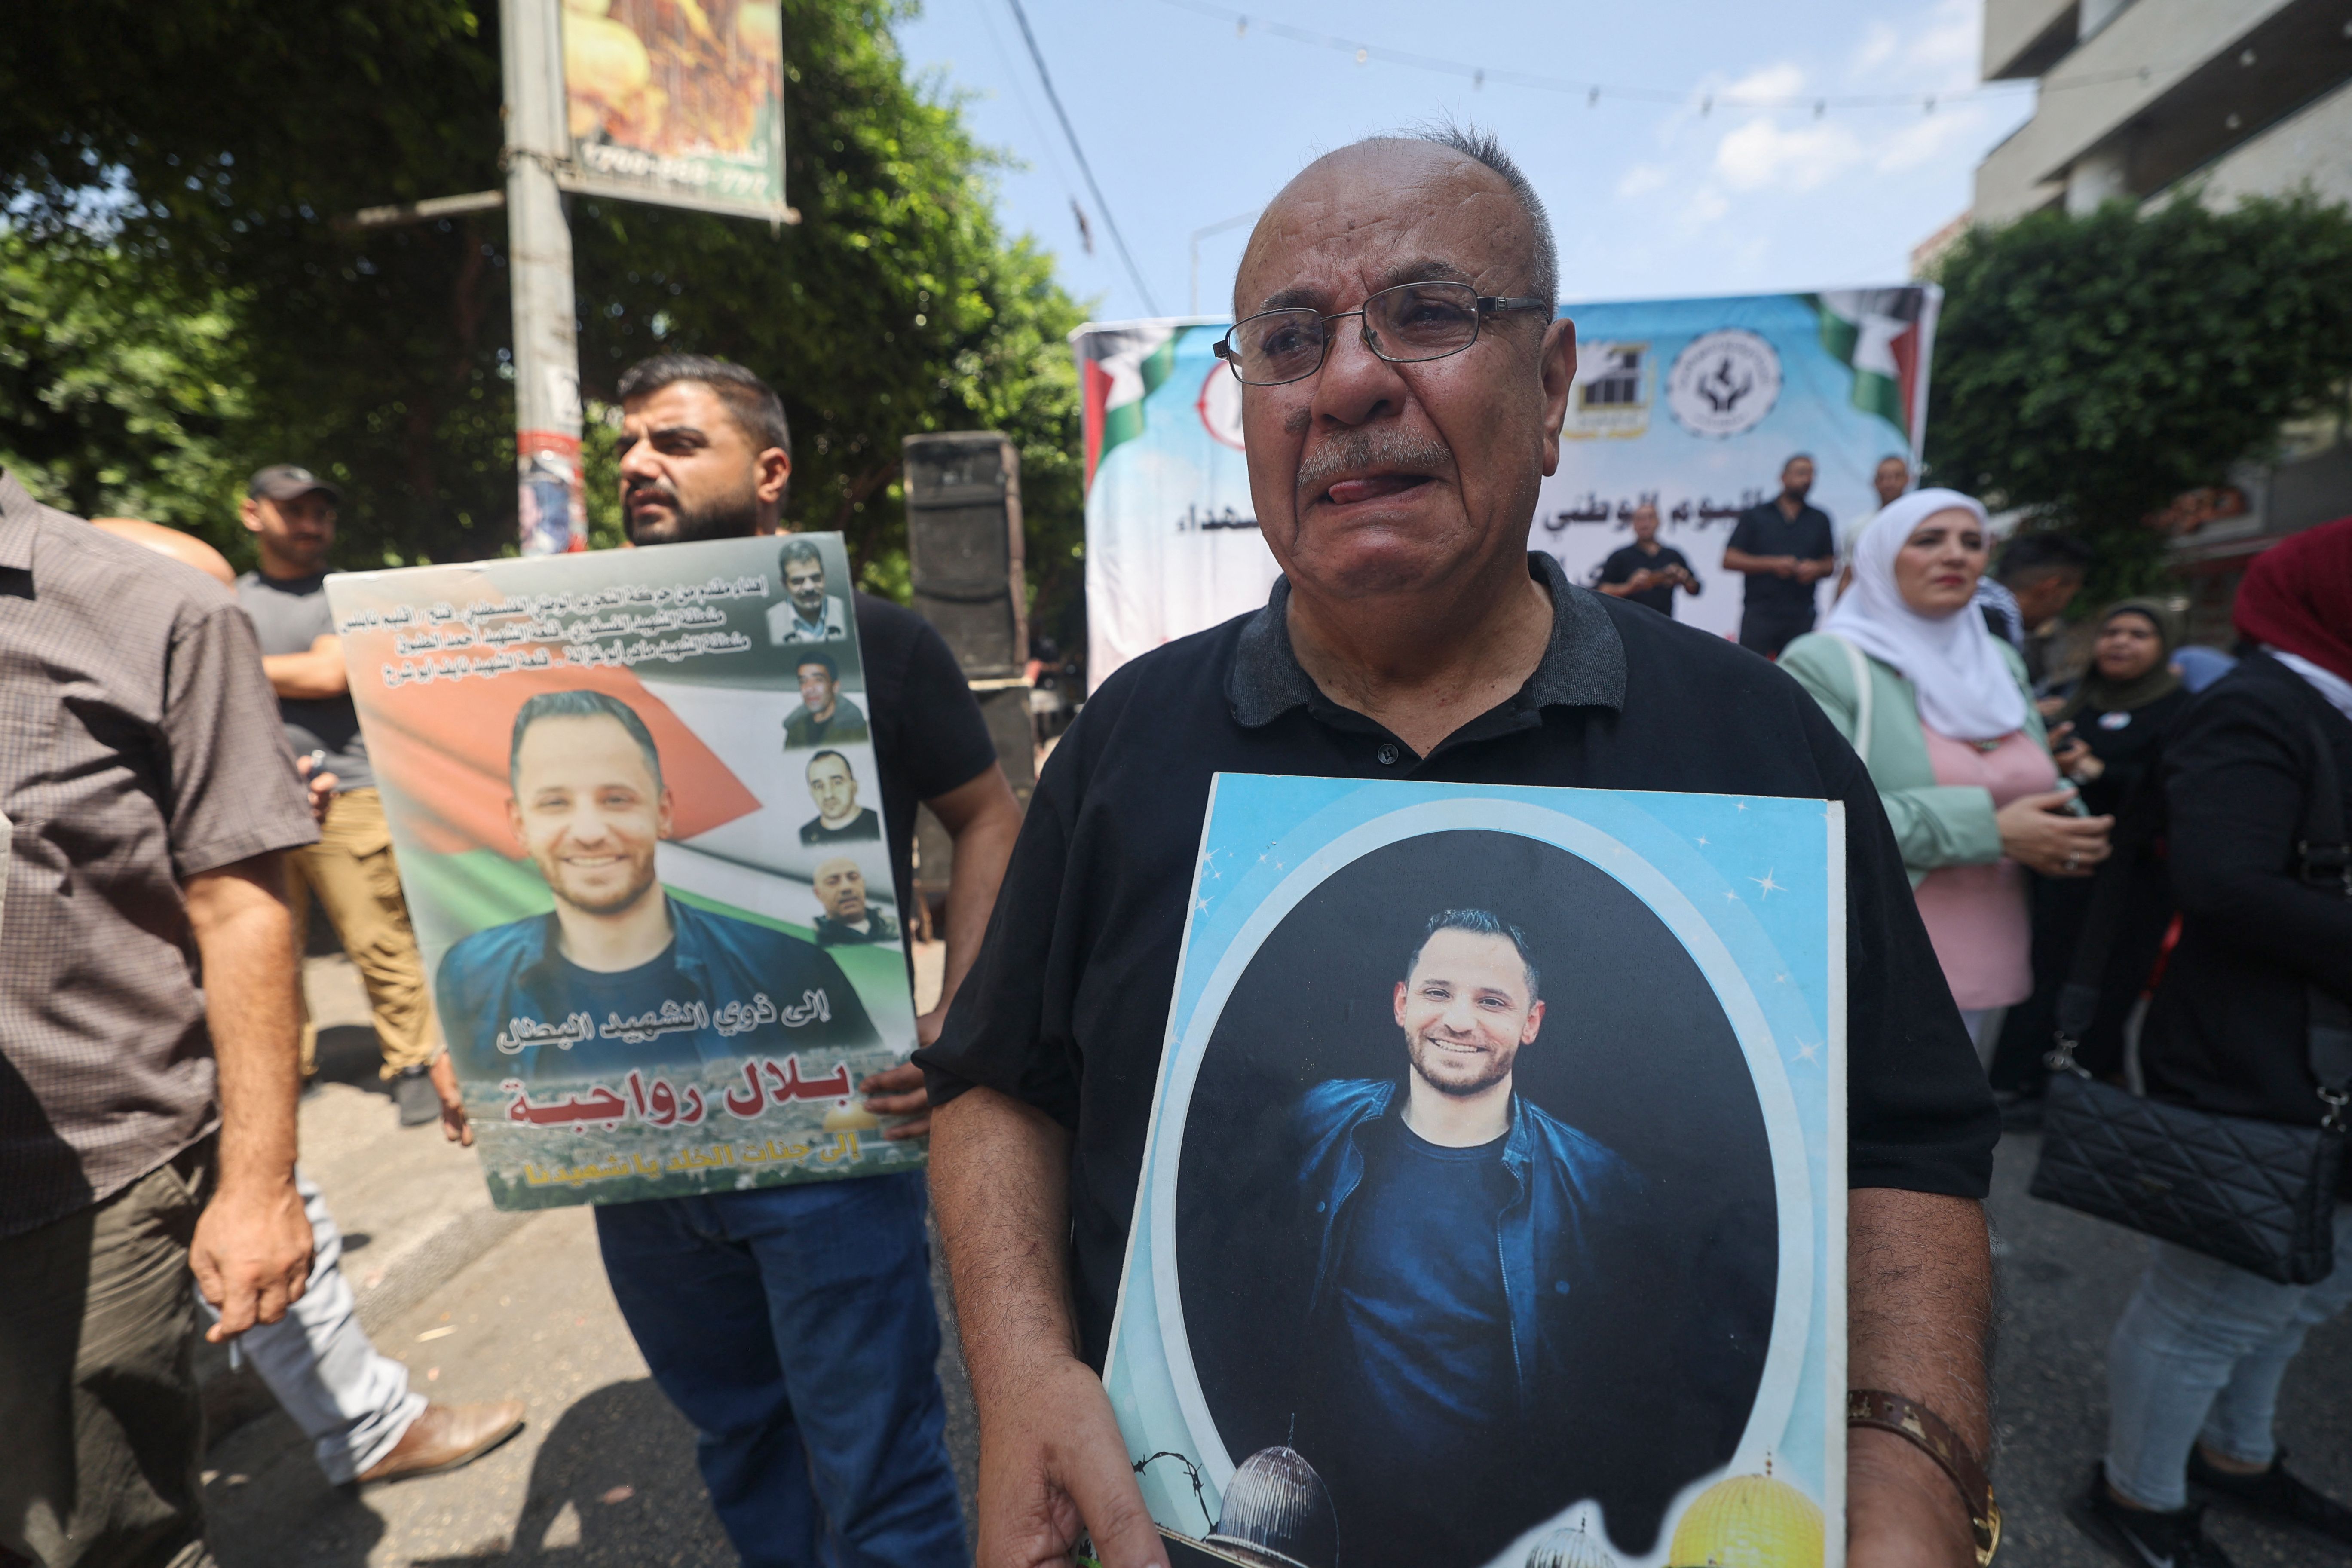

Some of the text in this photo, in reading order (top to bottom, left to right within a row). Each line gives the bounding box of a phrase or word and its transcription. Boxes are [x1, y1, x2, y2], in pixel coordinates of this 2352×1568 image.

[532, 591, 573, 622] الوطني
[574, 588, 627, 615] التحرير
[625, 585, 673, 607] حركة
[675, 584, 696, 606] من
[339, 608, 380, 635] نابلس
[427, 603, 454, 628] فتح
[464, 596, 532, 628] الفلسطيني
[634, 609, 679, 637] الشهيد
[482, 623, 531, 650] الشهيد
[658, 634, 705, 662] الشهيد
[472, 650, 521, 679] الشهيد
[496, 988, 832, 1055] إلى ذوي الشهيد البطل
[502, 1055, 851, 1133] بلال رواجبة
[666, 1144, 734, 1171] الخلد
[742, 1140, 811, 1165] جنات
[524, 1154, 629, 1187] شهيدنا
